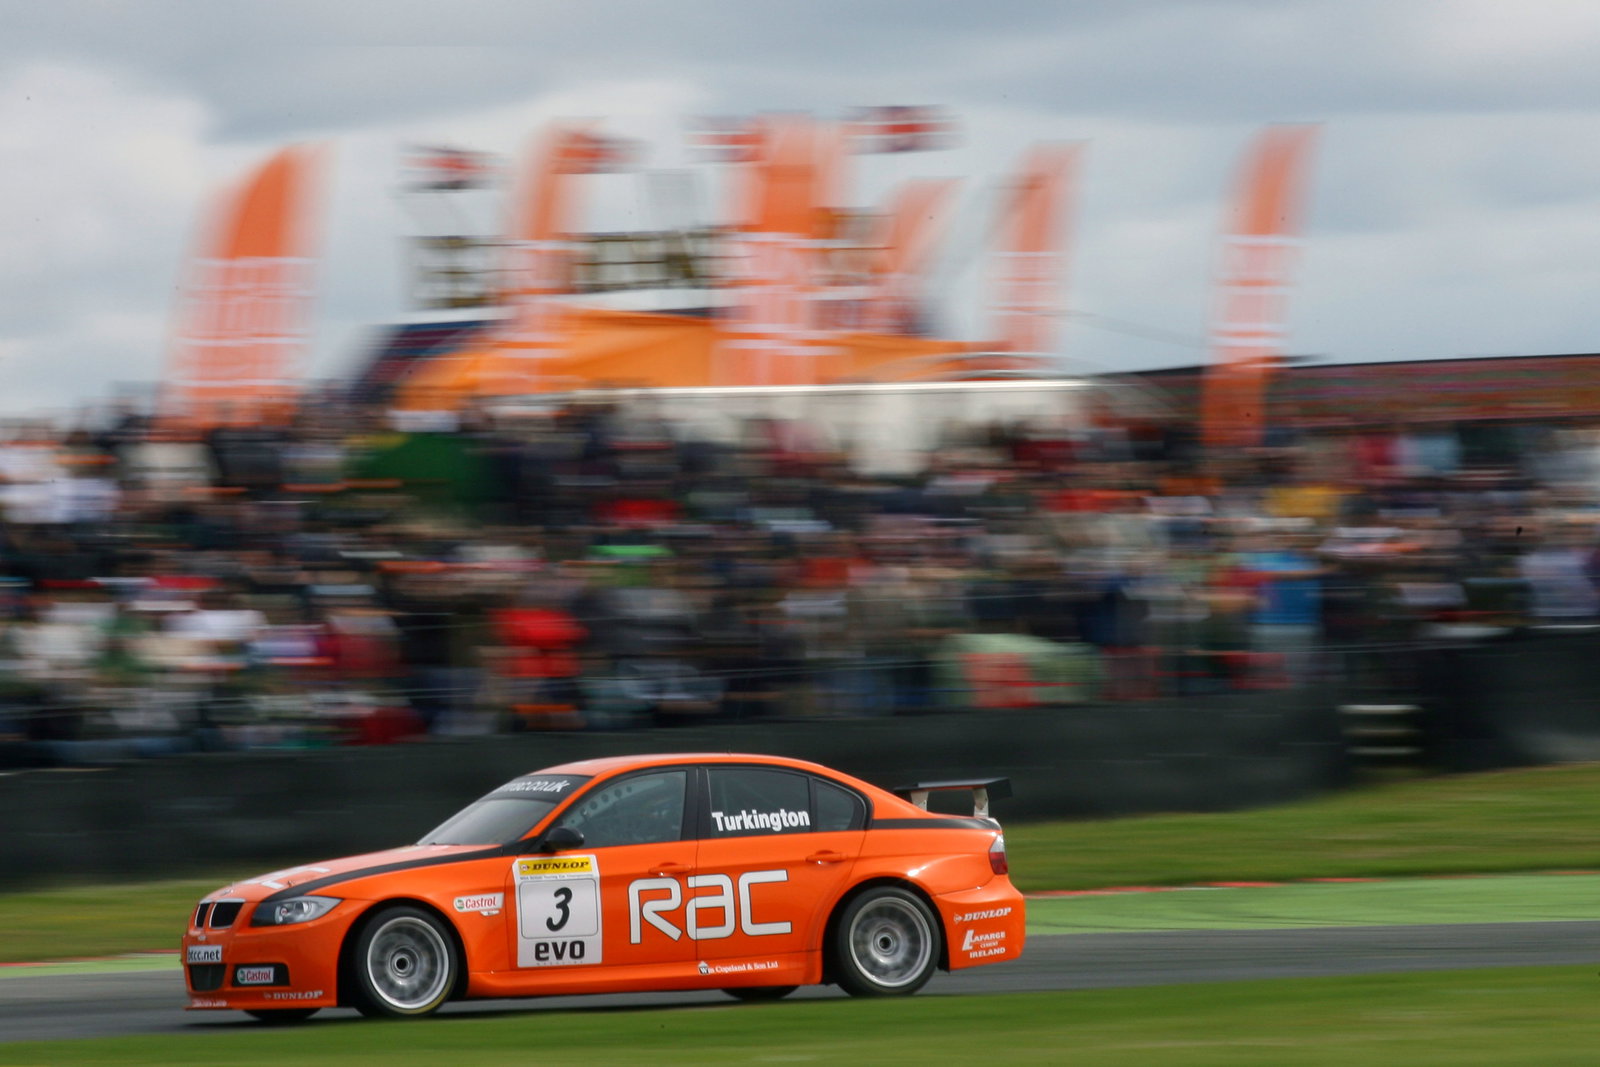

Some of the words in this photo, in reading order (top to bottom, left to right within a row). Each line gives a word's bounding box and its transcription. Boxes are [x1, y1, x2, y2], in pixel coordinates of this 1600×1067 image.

[711, 808, 811, 832] Turkington
[533, 861, 589, 871] DUNLOP
[465, 896, 497, 909] Castrol
[546, 887, 573, 932] 3
[963, 907, 1011, 921] DUNLOP
[962, 930, 1005, 950] LAFARGE
[534, 940, 585, 961] evo
[970, 947, 1005, 958] IRELAND
[715, 964, 746, 973] Copeland
[754, 962, 767, 970] Son
[246, 970, 272, 982] Castrol
[273, 990, 324, 1000] DUNLOP
